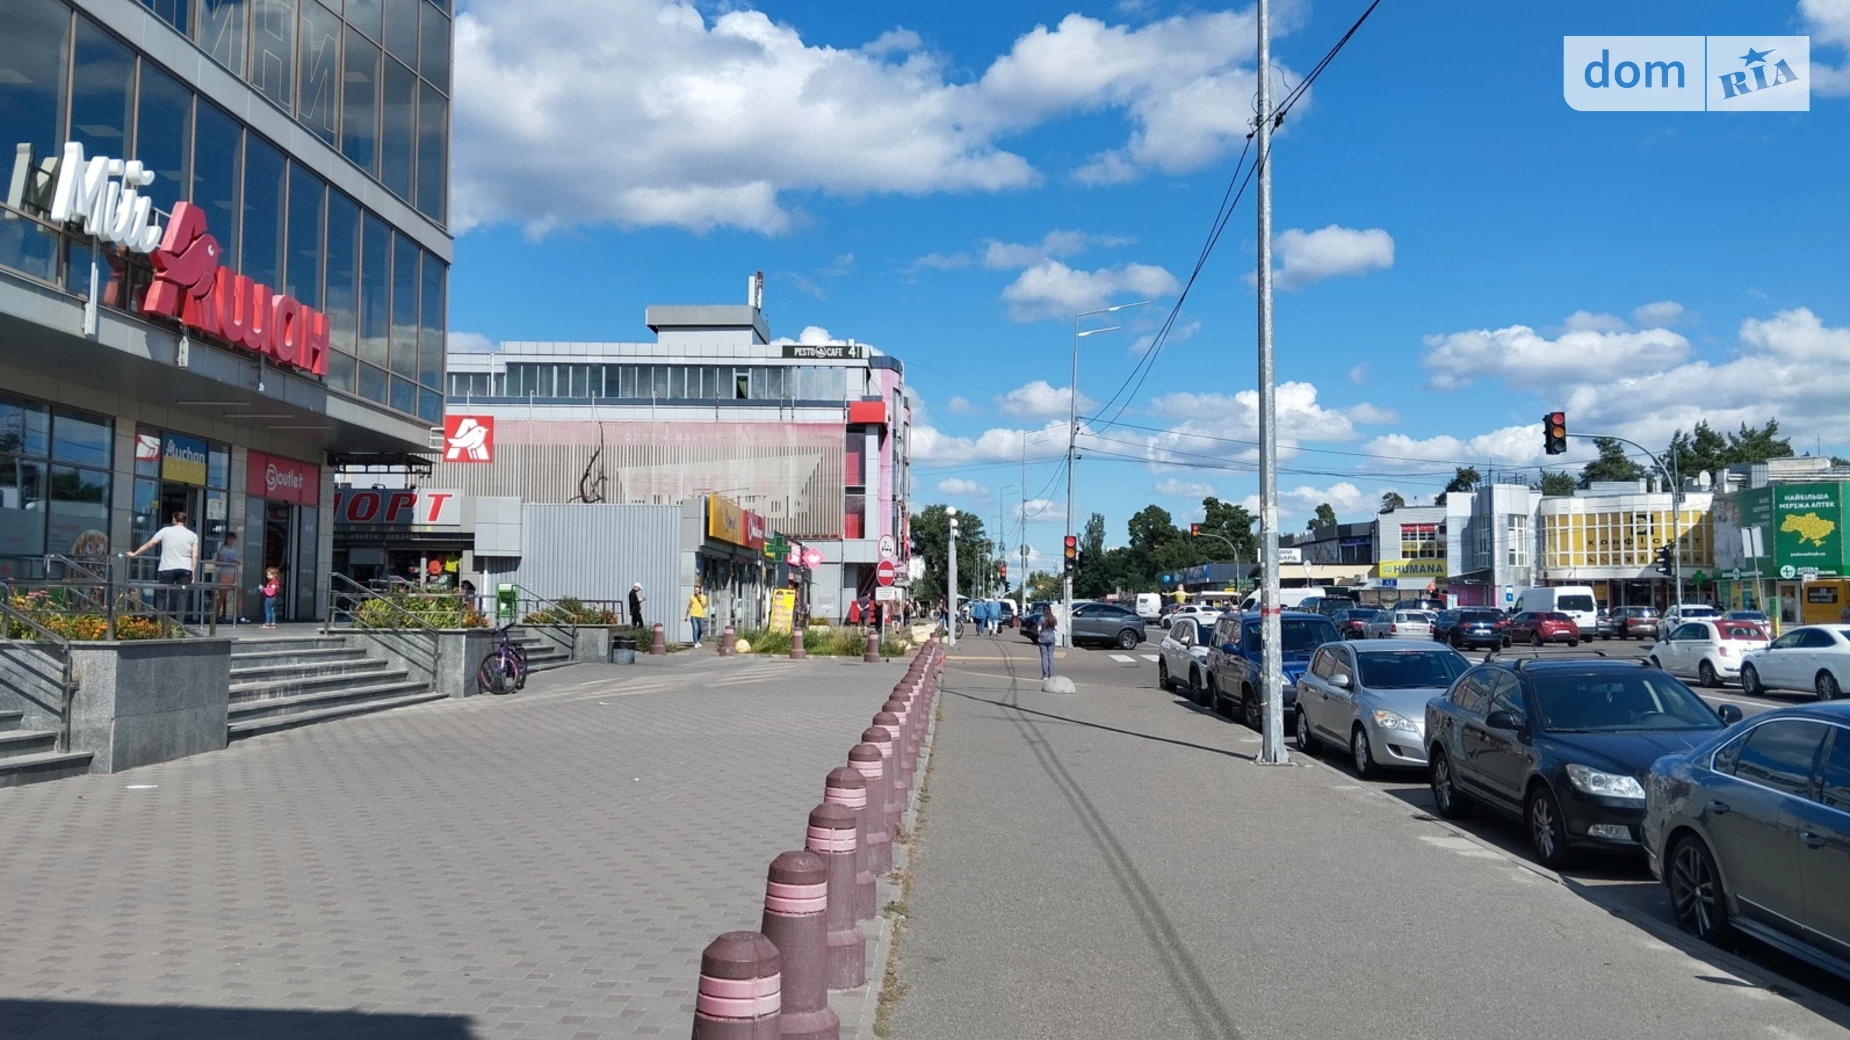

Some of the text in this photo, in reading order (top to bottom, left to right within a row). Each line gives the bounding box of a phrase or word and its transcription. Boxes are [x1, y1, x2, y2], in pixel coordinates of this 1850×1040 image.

[50, 142, 163, 253] Мій
[794, 347, 816, 357] PESTO
[826, 347, 844, 357] CAFE
[164, 439, 206, 464] Auchan
[1784, 493, 1829, 501] НАЙБІЛЬША
[1394, 564, 1444, 574] HUMANA
